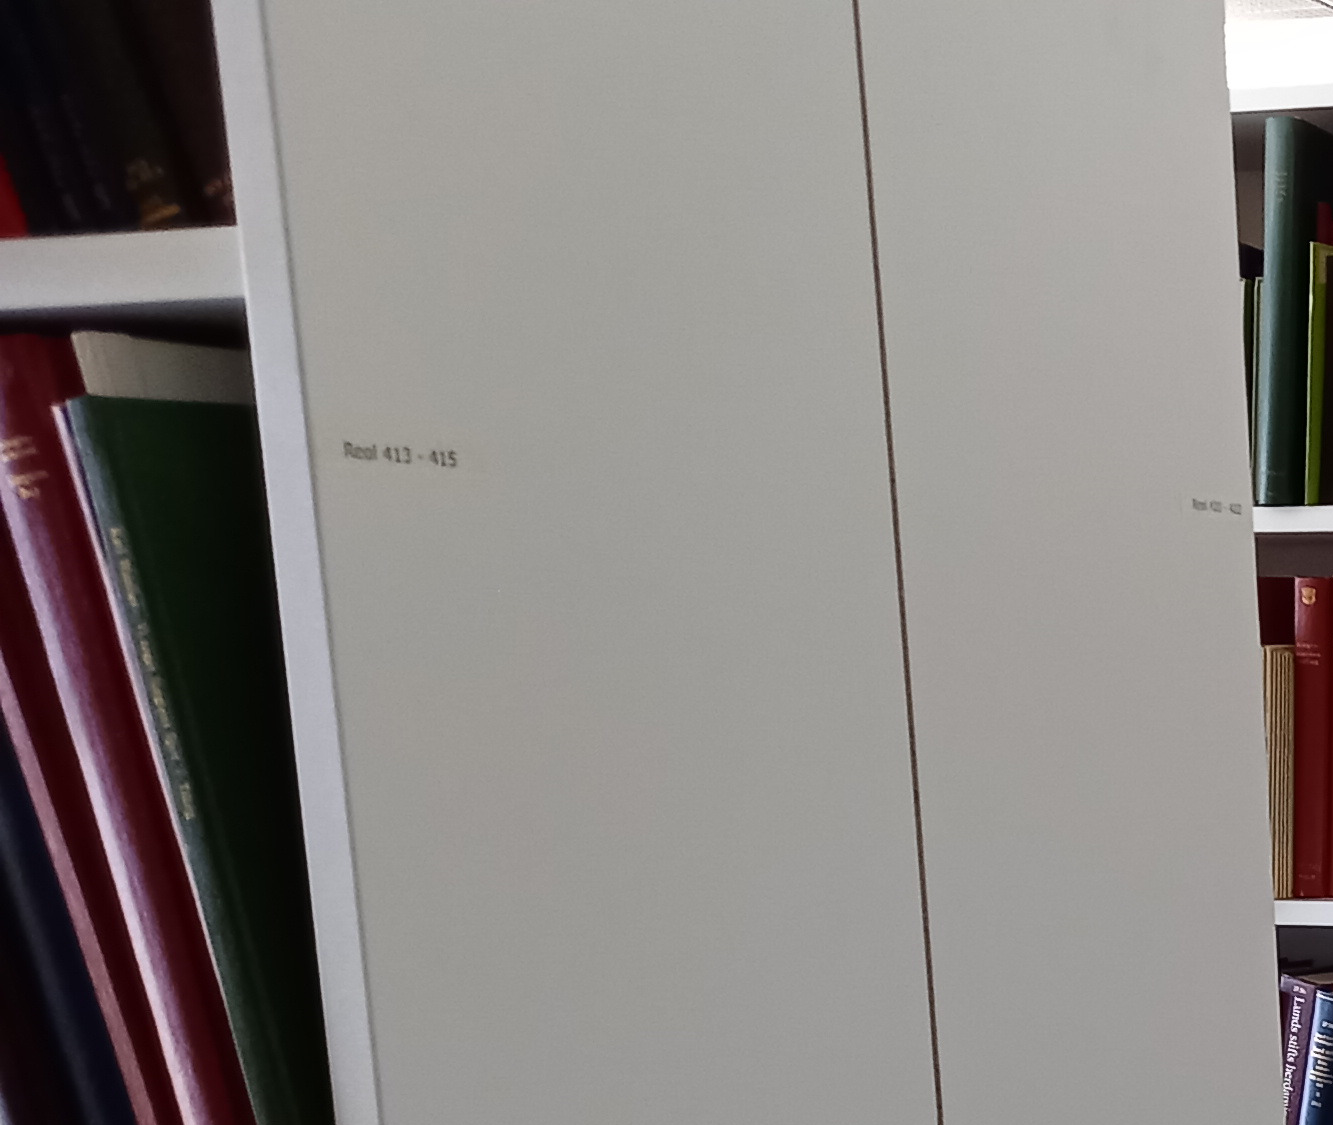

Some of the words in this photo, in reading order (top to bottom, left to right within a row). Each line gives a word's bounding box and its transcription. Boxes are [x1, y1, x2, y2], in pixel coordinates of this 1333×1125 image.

[383, 447, 411, 464] 413
[430, 450, 457, 467] 415
[1290, 996, 1305, 1033] Lunds
[1286, 1033, 1300, 1063] stifts
